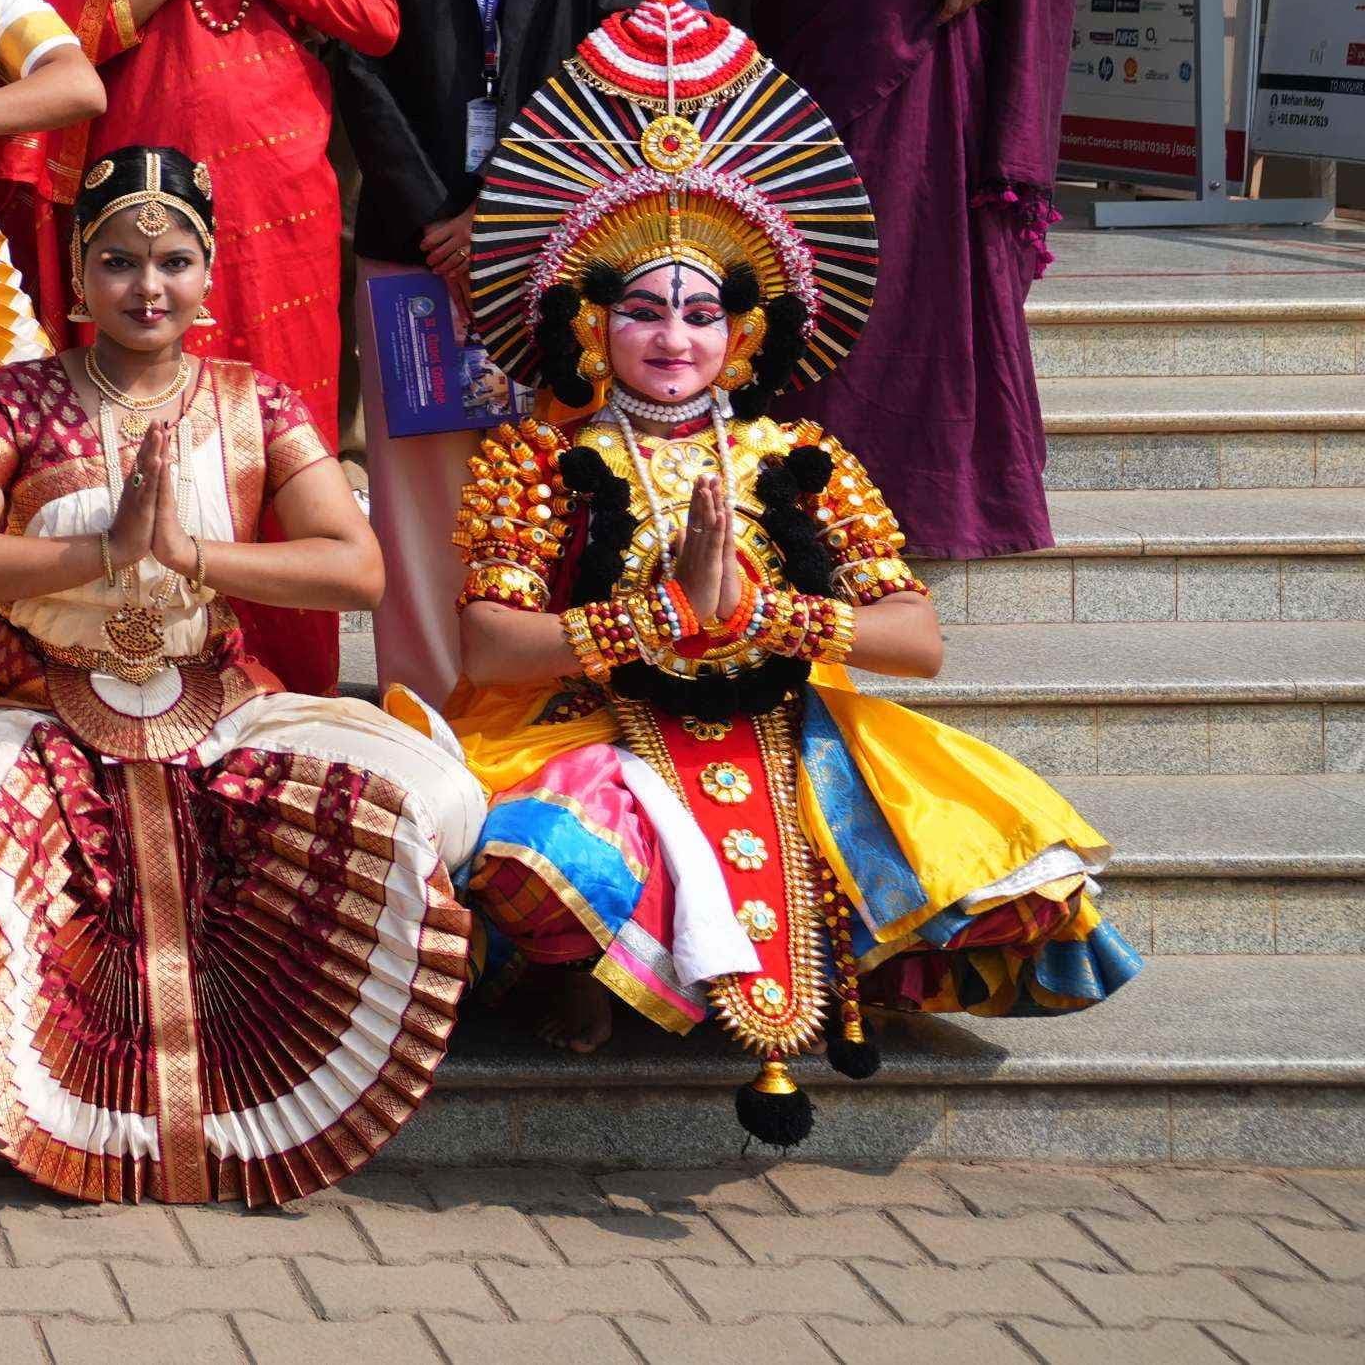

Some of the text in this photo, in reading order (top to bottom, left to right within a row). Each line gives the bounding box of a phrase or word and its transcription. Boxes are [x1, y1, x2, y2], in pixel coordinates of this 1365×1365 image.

[1117, 29, 1139, 46] NHS
[1280, 94, 1325, 111] Mohan Reddy
